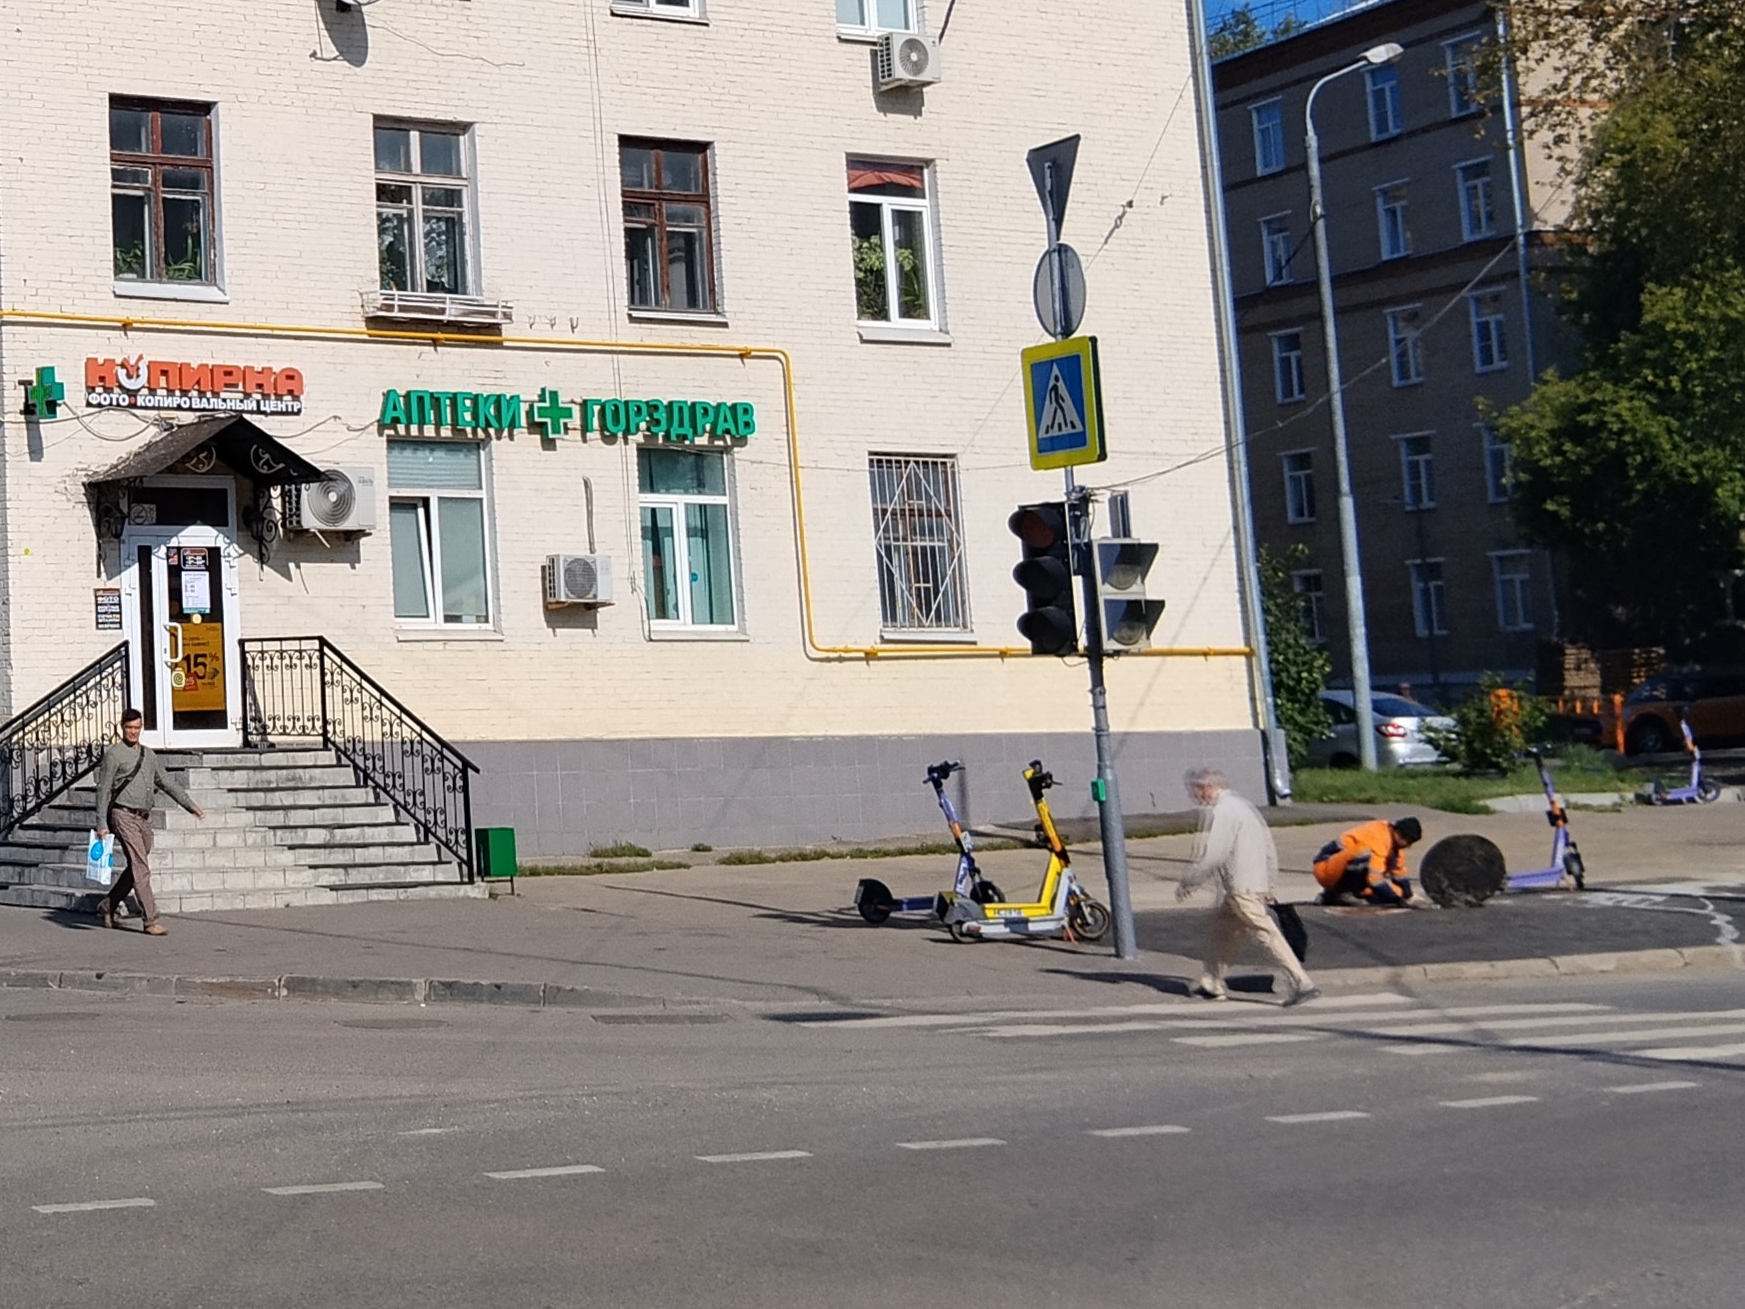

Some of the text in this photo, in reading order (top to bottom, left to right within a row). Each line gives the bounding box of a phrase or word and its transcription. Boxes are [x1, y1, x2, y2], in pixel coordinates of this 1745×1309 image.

[85, 353, 304, 396] КОПИРКА
[88, 393, 129, 407] ФОТО
[259, 398, 301, 414] ЦЕНТР
[379, 389, 756, 442] АПТЕКИ ГОРЗДРАВ
